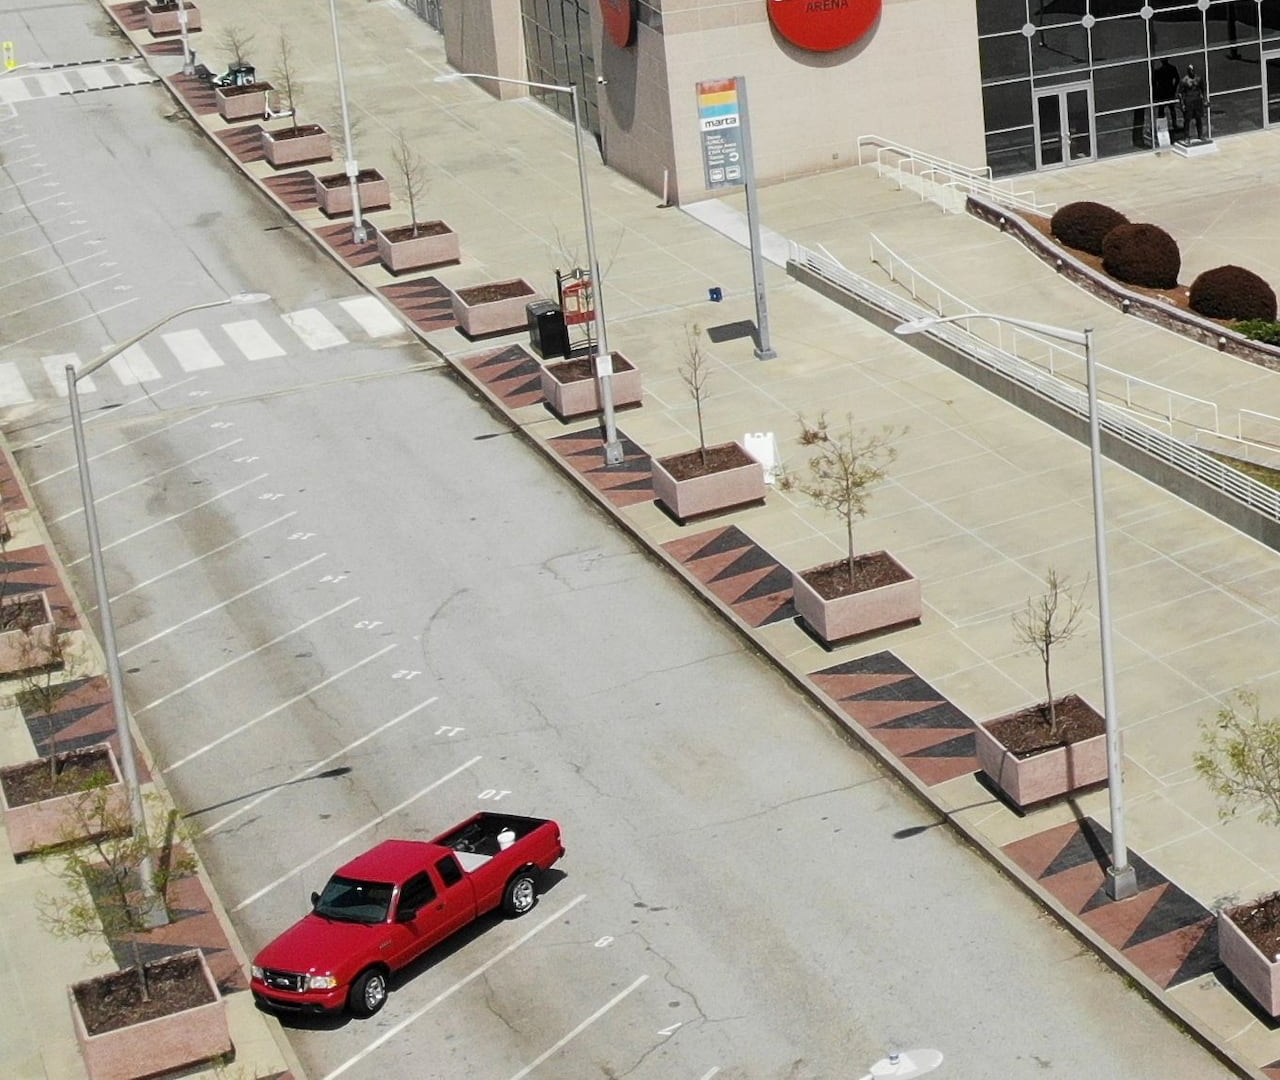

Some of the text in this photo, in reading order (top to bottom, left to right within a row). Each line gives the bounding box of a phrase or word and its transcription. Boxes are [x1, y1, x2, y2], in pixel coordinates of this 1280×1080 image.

[705, 117, 737, 128] marta
[319, 575, 348, 583] 14
[353, 620, 384, 629] 13
[391, 670, 422, 680] 12
[434, 725, 465, 737] 11
[477, 789, 512, 801] 10
[594, 935, 615, 948] 8
[656, 1022, 683, 1035] 7
